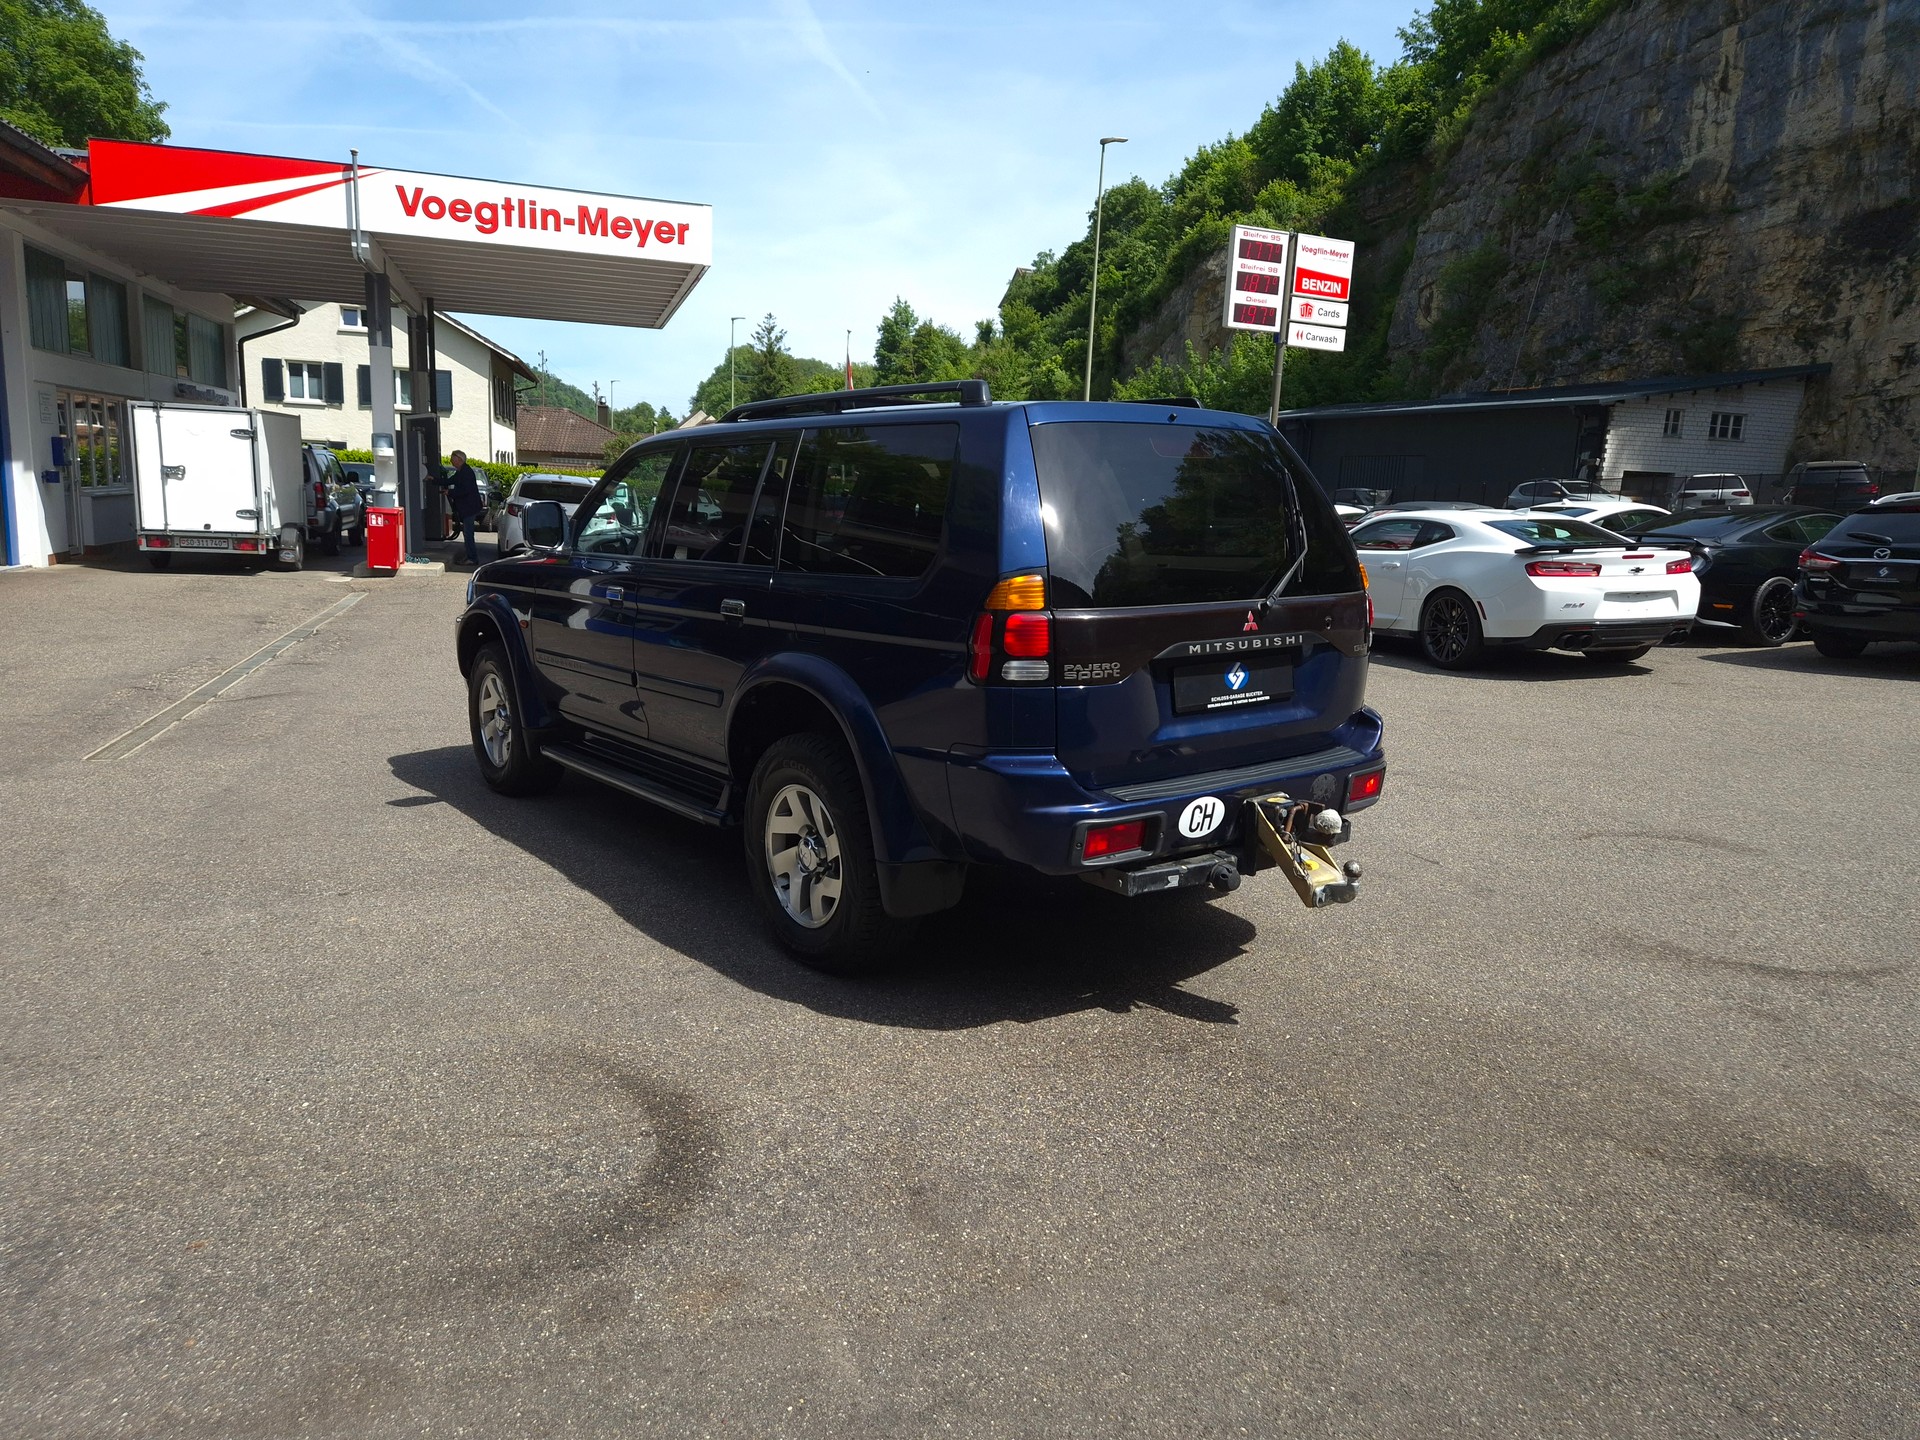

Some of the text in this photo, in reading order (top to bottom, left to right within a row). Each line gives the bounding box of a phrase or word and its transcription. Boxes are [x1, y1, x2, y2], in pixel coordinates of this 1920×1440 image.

[395, 185, 690, 248] Voegtlin-Meyer
[1243, 231, 1268, 240] Bleifrei
[1301, 244, 1349, 259] Voegtlin-Meyer
[1240, 263, 1266, 272] Bleifrei
[1302, 278, 1341, 294] BENZIN
[1245, 296, 1267, 304] Diesel
[1317, 307, 1340, 319] Cards
[1305, 332, 1338, 344] Carwash
[1189, 634, 1304, 655] MITSUBISHI
[1063, 661, 1121, 672] PAJERO
[1188, 801, 1217, 833] CH
